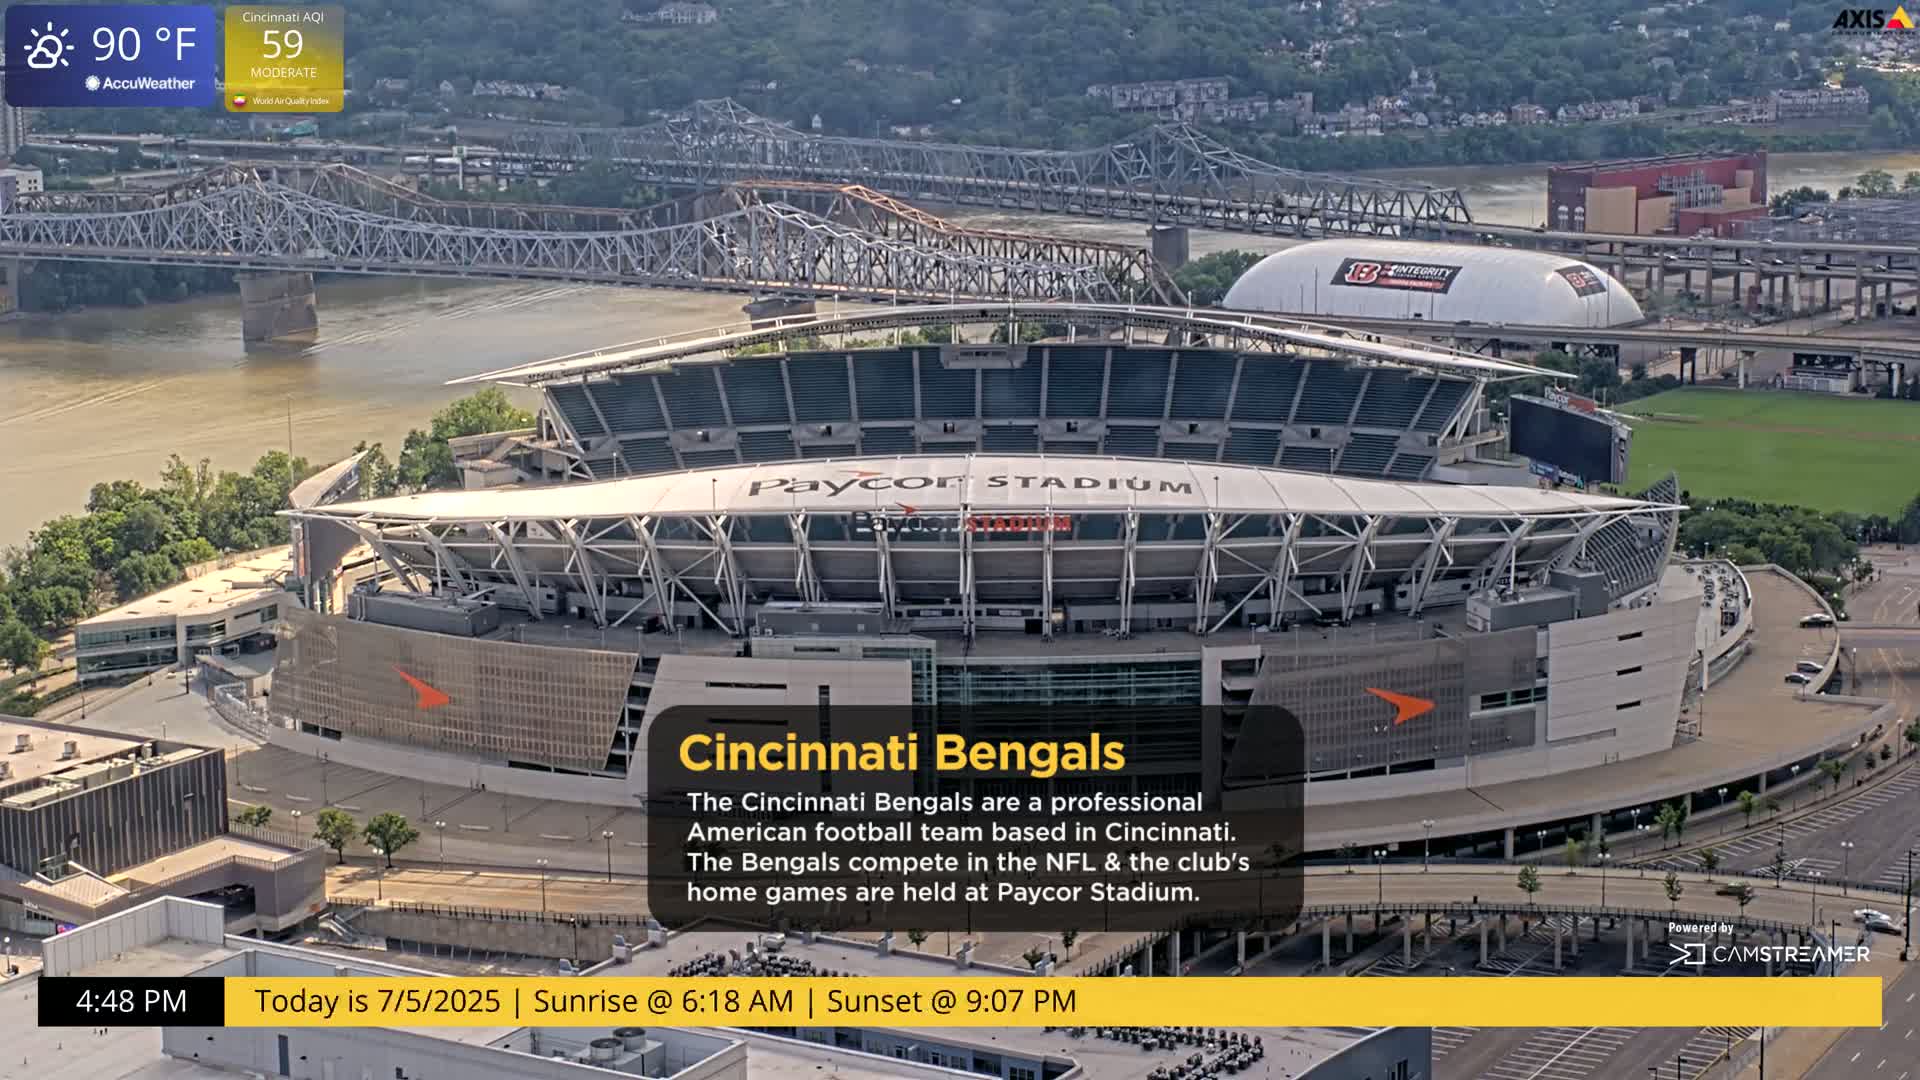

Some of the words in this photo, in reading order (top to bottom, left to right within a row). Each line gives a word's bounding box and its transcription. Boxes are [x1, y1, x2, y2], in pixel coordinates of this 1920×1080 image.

[1396, 264, 1453, 277] INTEGRITY
[748, 475, 966, 497] Paycor
[987, 475, 1193, 495] STADIUM
[966, 513, 1073, 533] STADIUM
